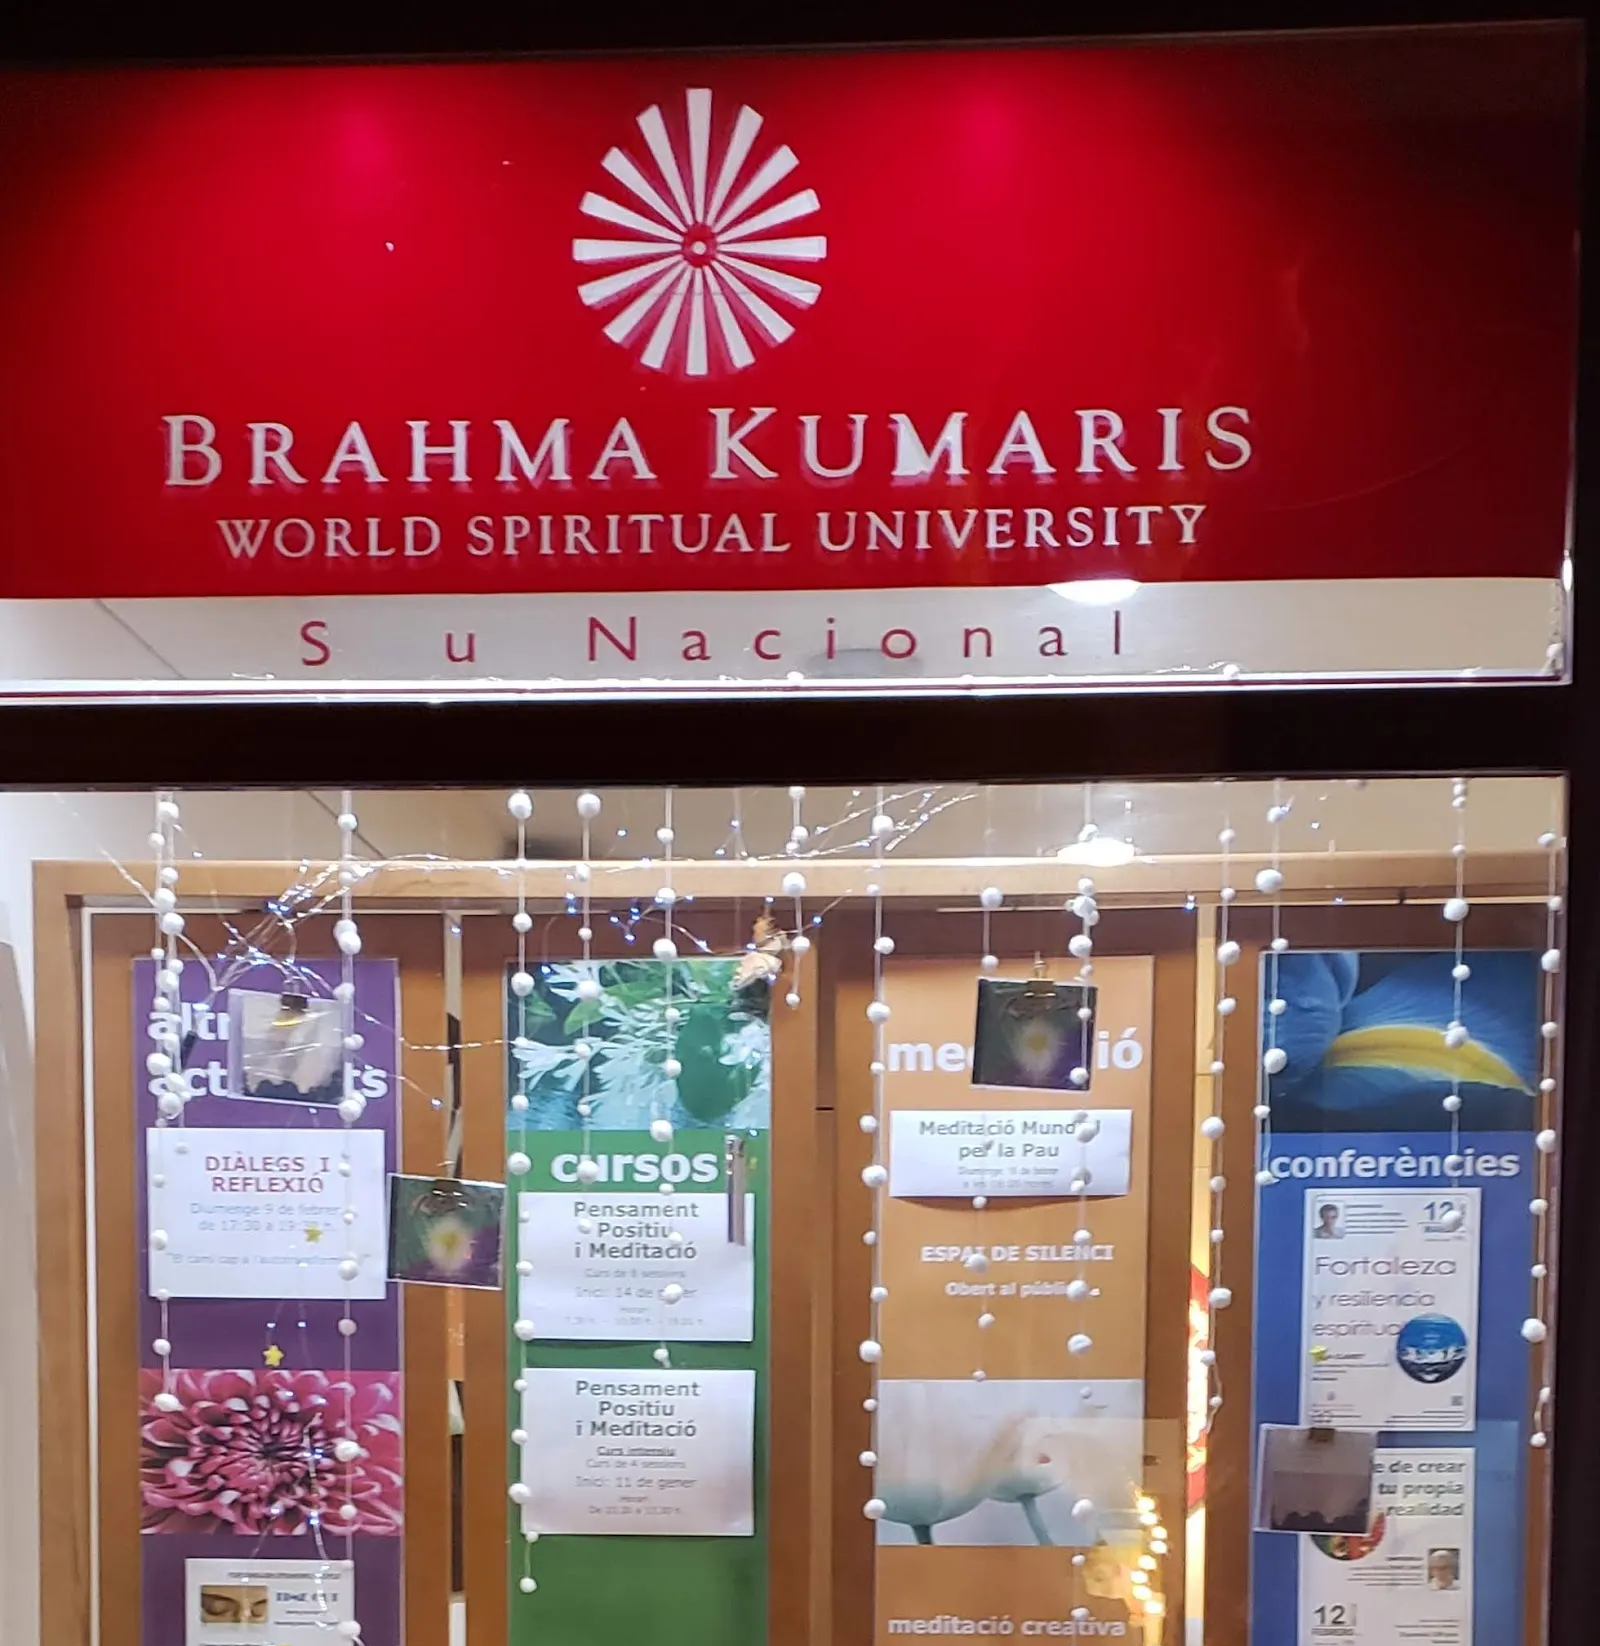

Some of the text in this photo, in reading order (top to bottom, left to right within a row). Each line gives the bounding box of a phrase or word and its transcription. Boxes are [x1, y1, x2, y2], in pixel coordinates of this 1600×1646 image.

[161, 405, 1253, 487] BRAHMA KUMARIS
[217, 504, 1207, 560] WORLD SPIRITUAL UNIVERSITY
[588, 609, 1121, 663] Nacional
[919, 1119, 1101, 1136] Meditació Mundl
[997, 1142, 1015, 1158] la
[1021, 1142, 1060, 1158] Pau
[205, 1150, 331, 1173] DIÀLEGS I
[1269, 1147, 1520, 1178] conferències
[211, 1172, 324, 1194] REFLEXIÓ
[574, 1201, 700, 1218] Pensament
[597, 1221, 673, 1239] Positiu
[575, 1241, 697, 1259] i Meditació
[991, 1245, 1020, 1262] DE
[1024, 1244, 1115, 1262] SILENCI
[1315, 1256, 1457, 1276] Fortaleza
[945, 1281, 997, 1296] Obert
[1000, 1281, 1017, 1296] al
[1329, 1289, 1436, 1307] resiliencia
[1312, 1319, 1402, 1339] espiritua
[575, 1380, 701, 1396] Pensament
[598, 1399, 675, 1417] Positiu
[575, 1418, 697, 1437] i Meditació
[1388, 1460, 1413, 1474] de
[1417, 1462, 1467, 1474] crear
[1377, 1480, 1465, 1499] tu propia
[1313, 1604, 1346, 1625] 12
[887, 1614, 1127, 1637] meditació creativa
